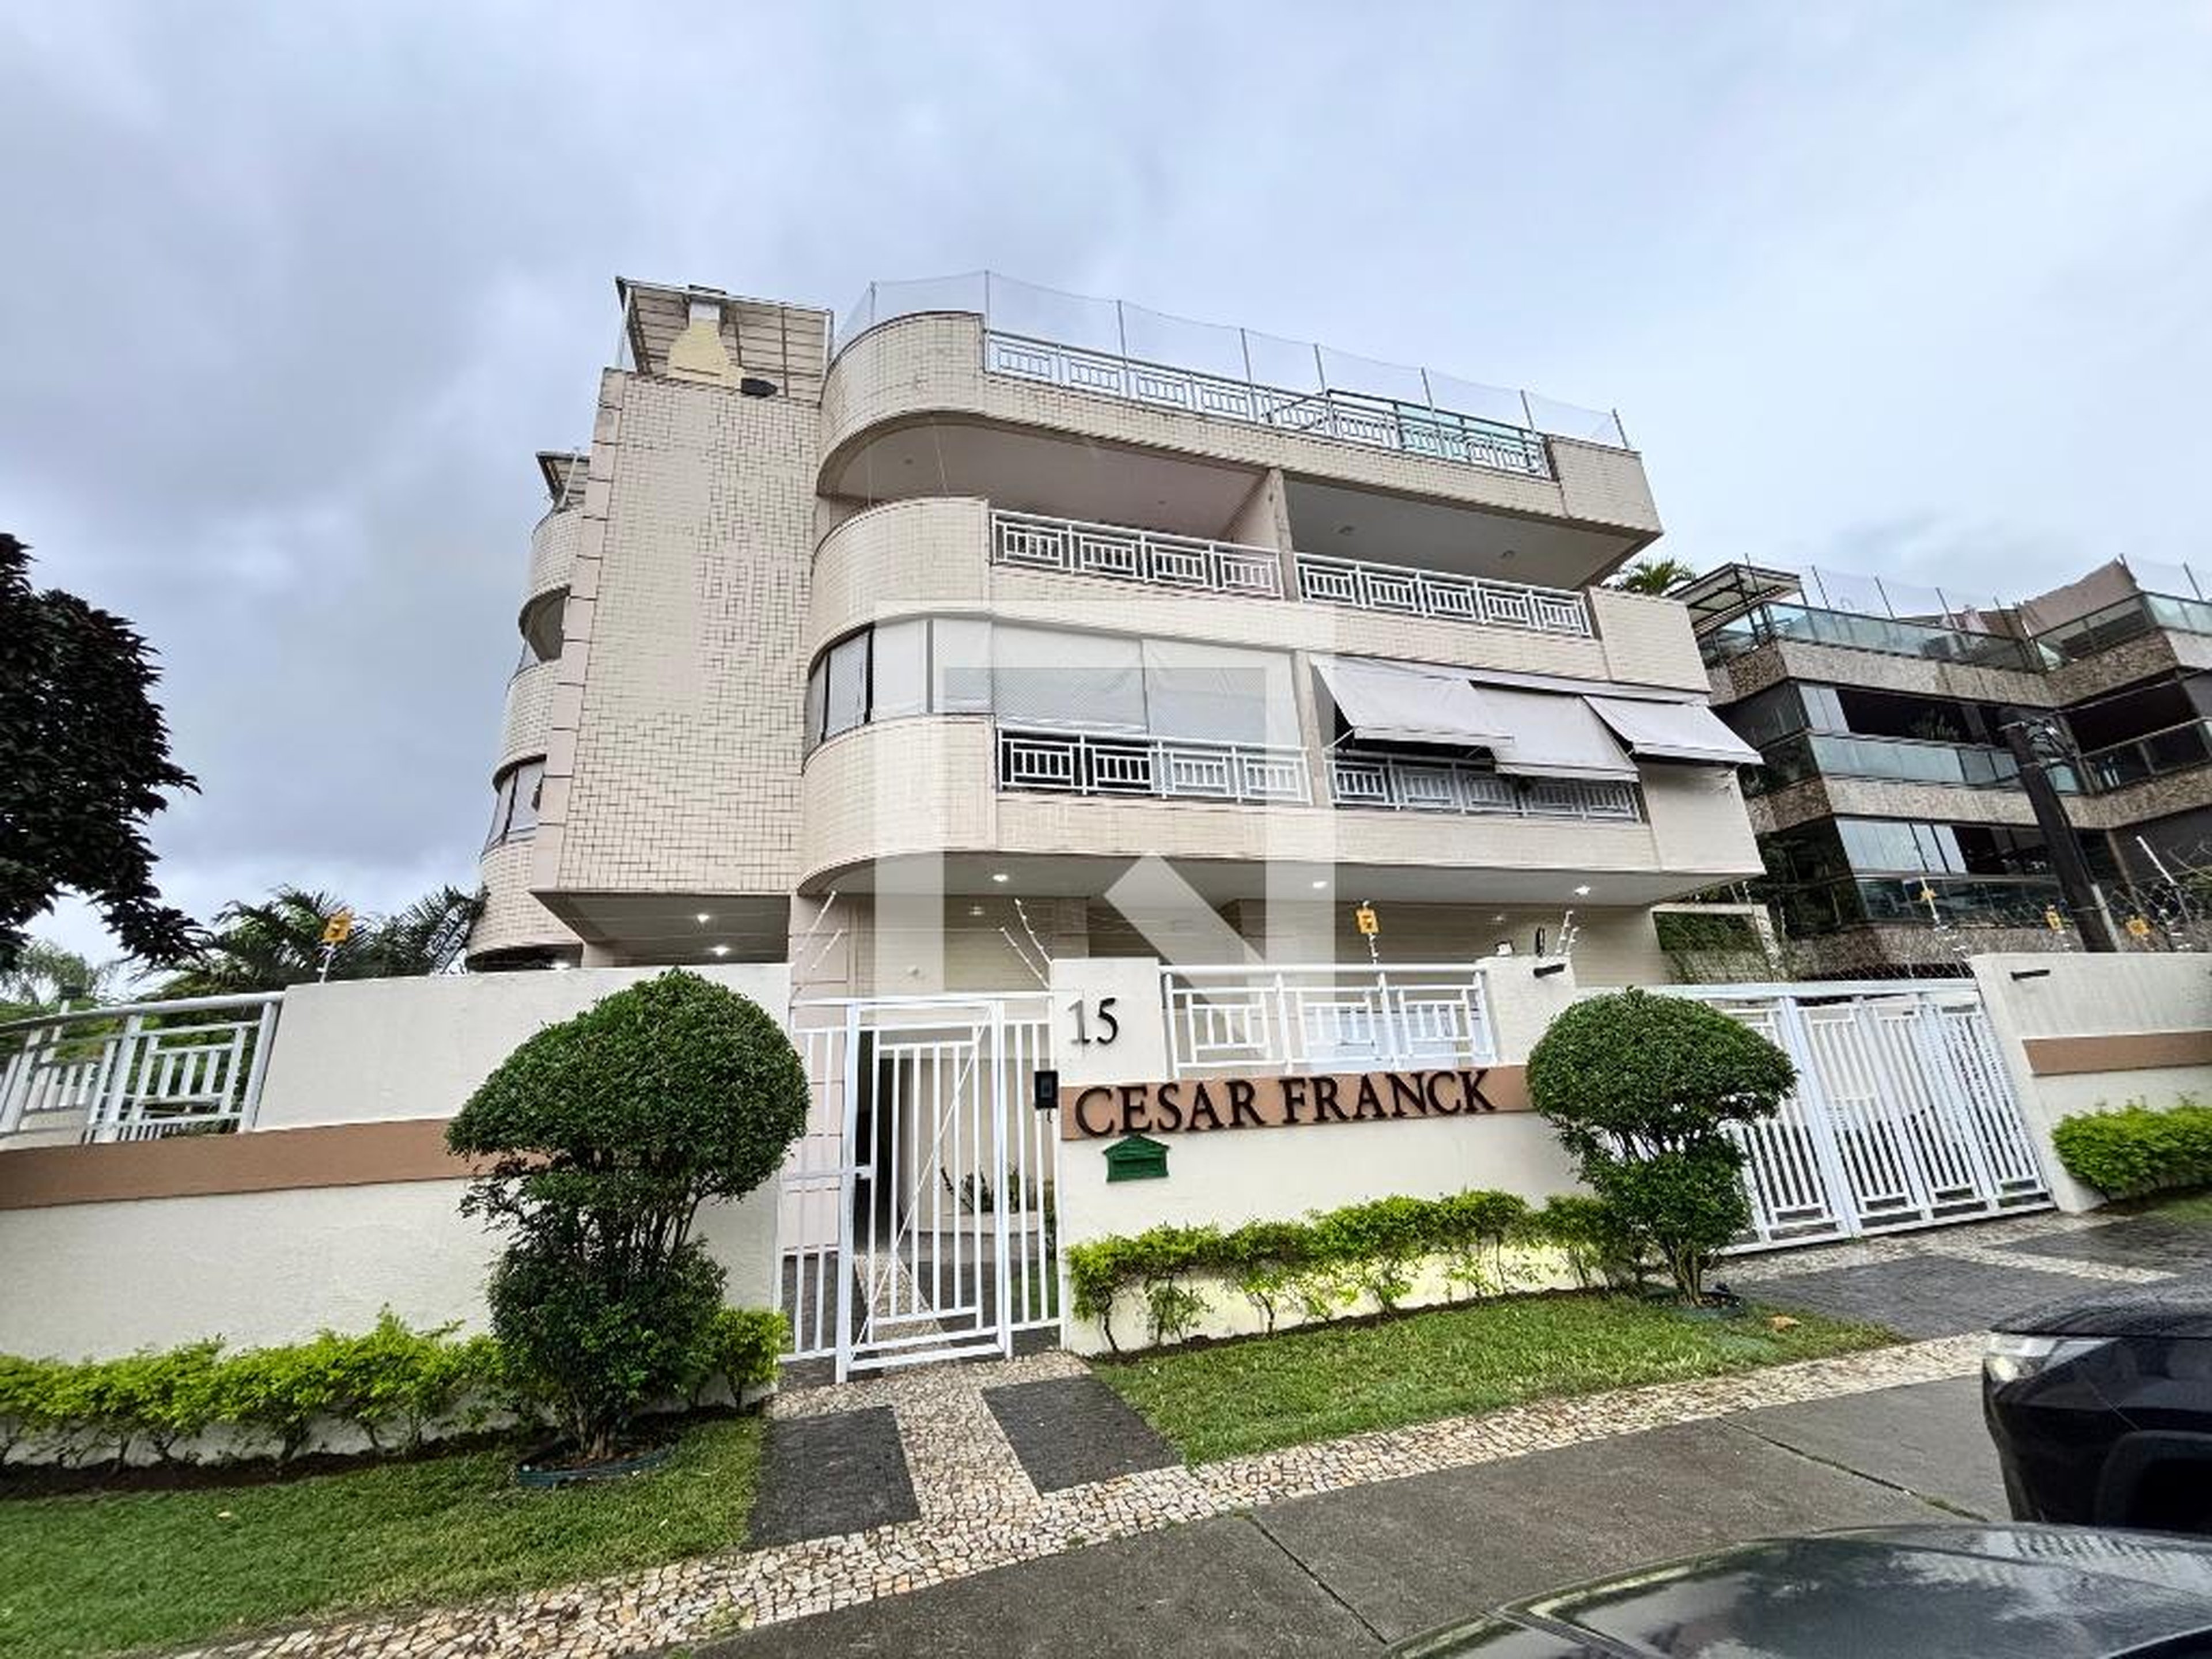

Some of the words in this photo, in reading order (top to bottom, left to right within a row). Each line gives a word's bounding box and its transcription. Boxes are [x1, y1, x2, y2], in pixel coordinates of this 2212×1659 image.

[1068, 997, 1119, 1045] 15
[1075, 1079, 1267, 1137] CESAR
[1278, 1069, 1497, 1124] FRANCK
